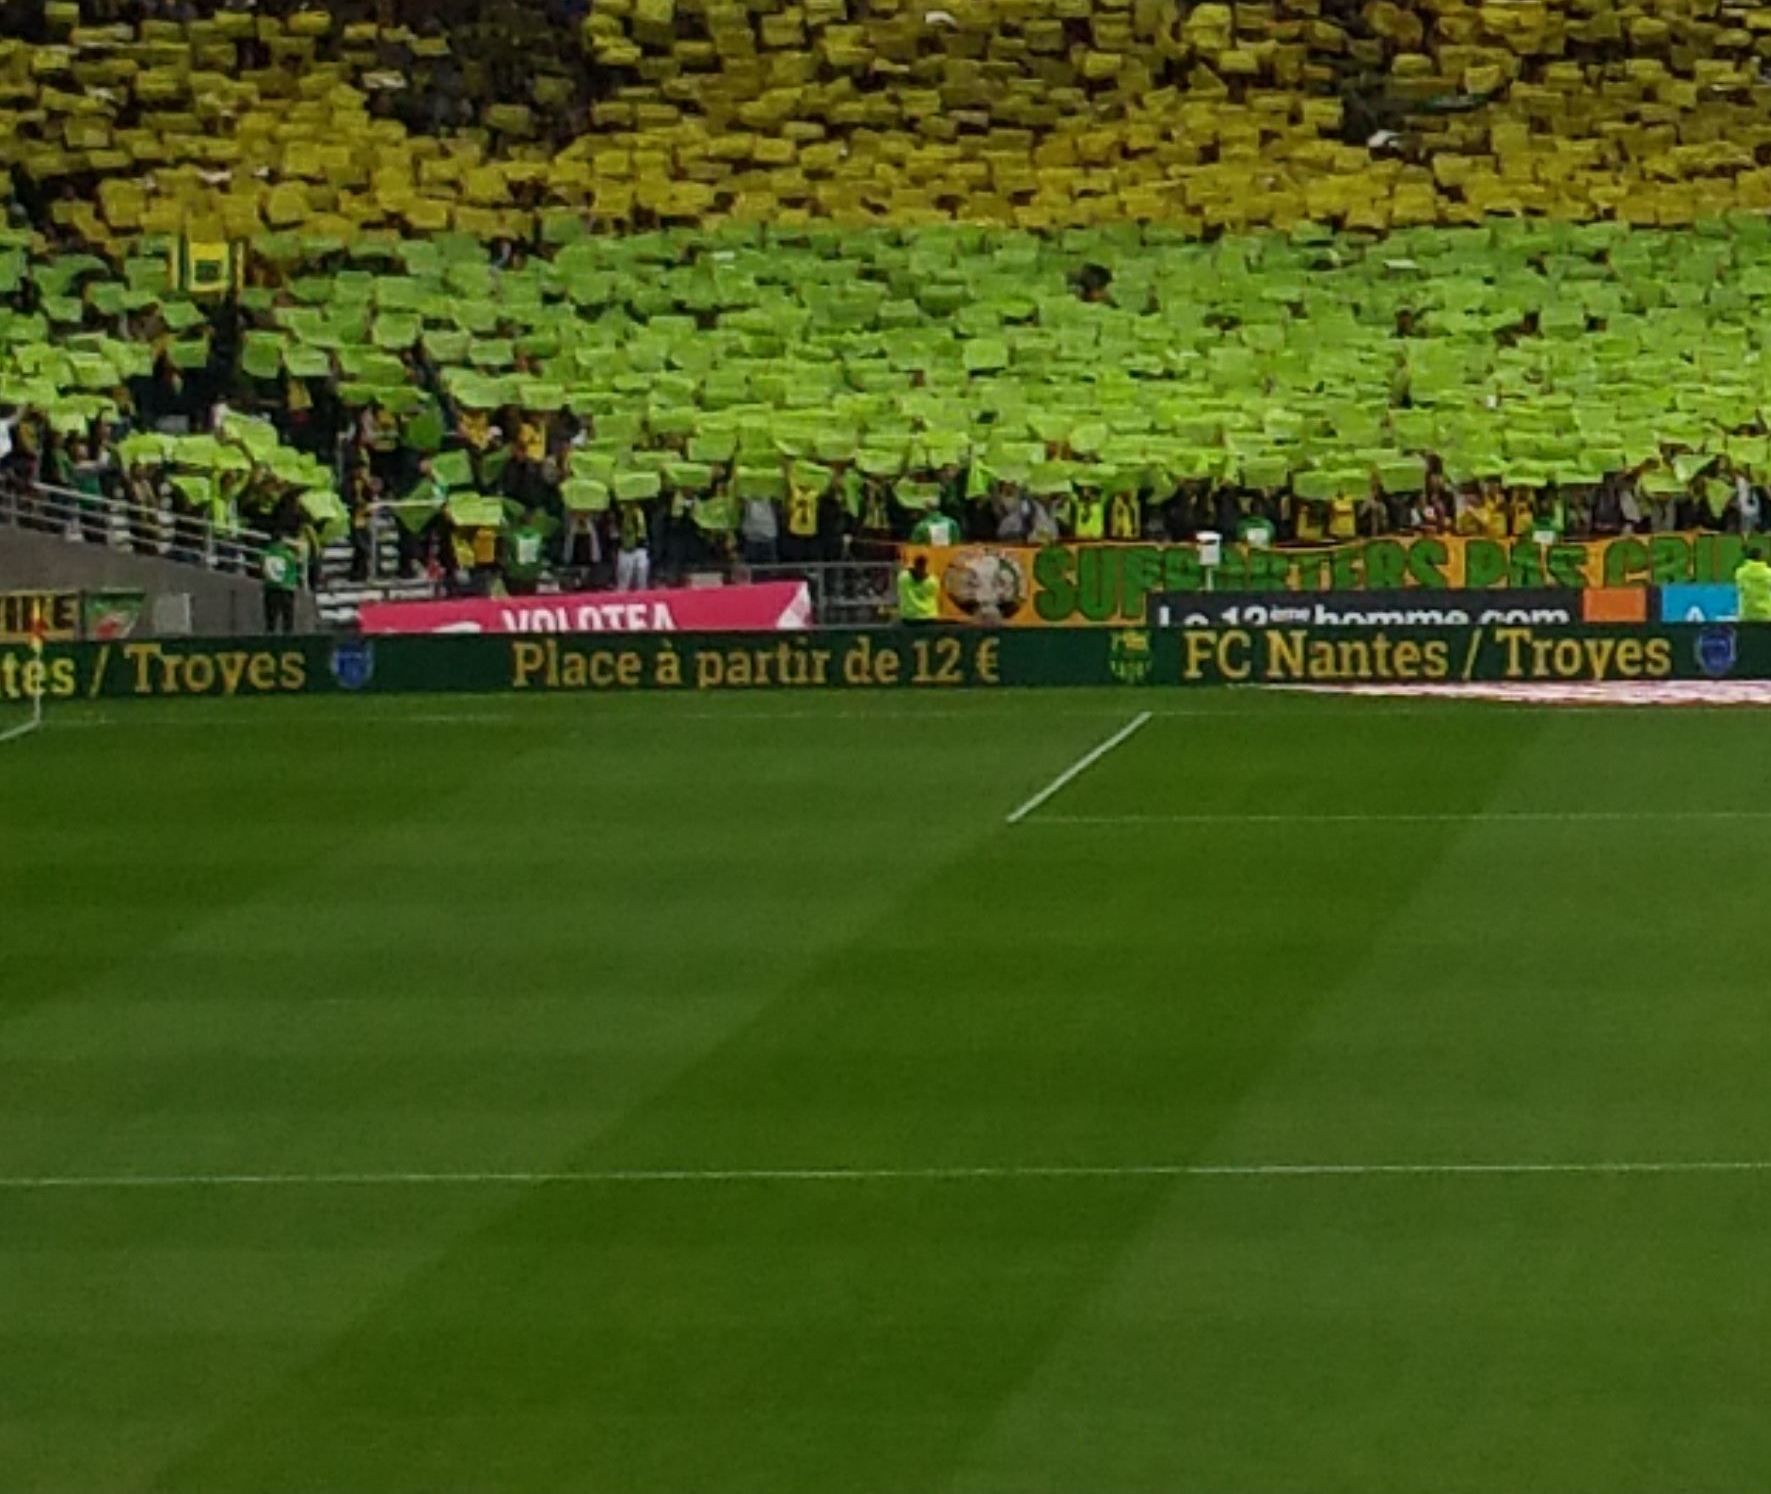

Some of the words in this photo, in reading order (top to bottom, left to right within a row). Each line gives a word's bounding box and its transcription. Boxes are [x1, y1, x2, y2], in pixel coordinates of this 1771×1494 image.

[124, 643, 306, 694] Troyes
[513, 638, 643, 688] Place
[655, 638, 682, 686] à
[697, 638, 831, 688] partir
[844, 635, 899, 684] de
[911, 637, 964, 683] 12
[1183, 629, 1251, 680] FC
[1266, 628, 1449, 680] Nantes
[1495, 628, 1672, 681] Troyes
